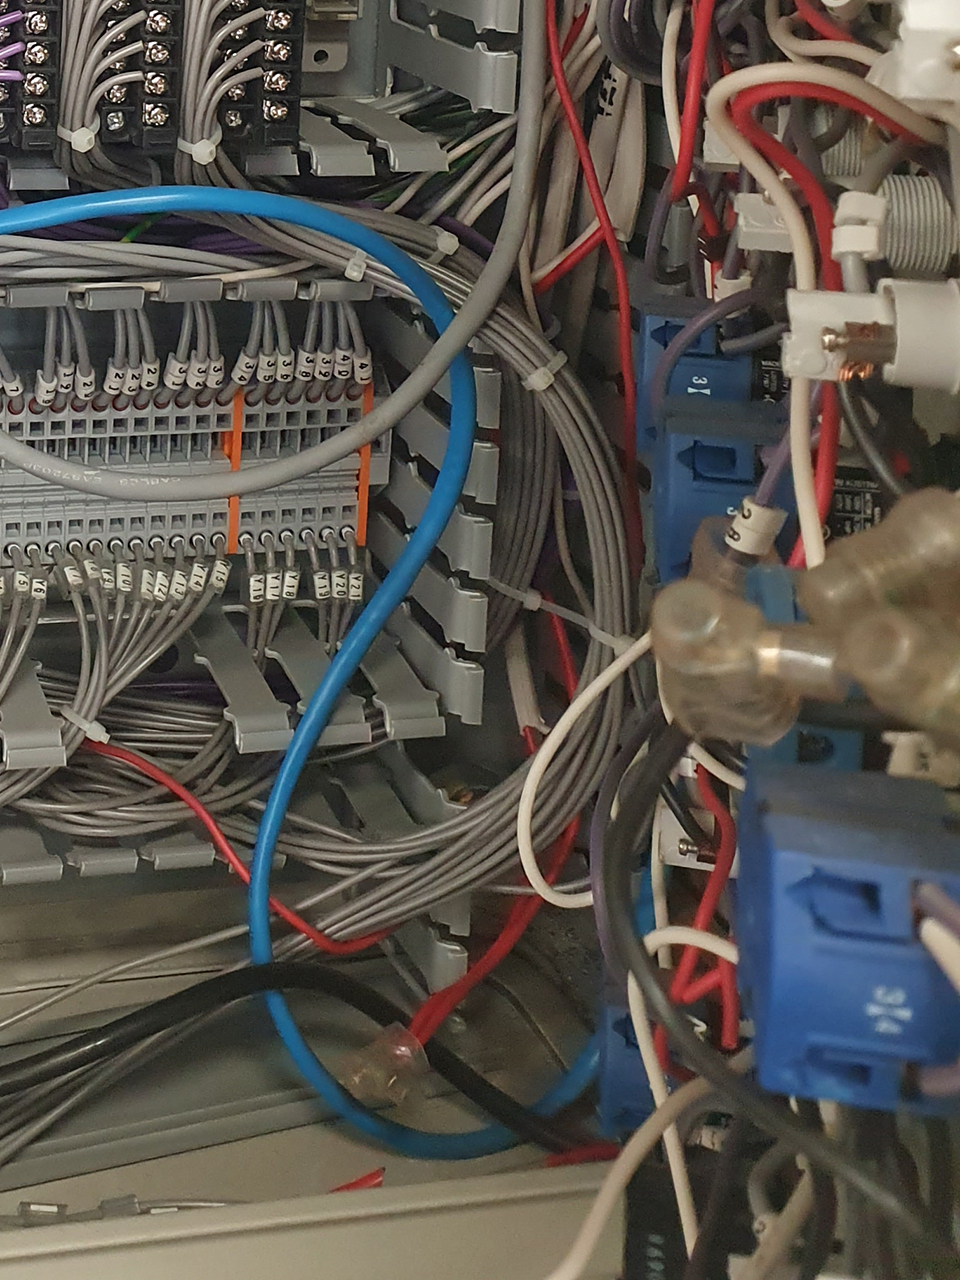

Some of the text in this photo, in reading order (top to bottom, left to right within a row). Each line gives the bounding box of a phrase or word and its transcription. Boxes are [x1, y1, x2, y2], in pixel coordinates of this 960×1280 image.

[263, 360, 276, 381] 35
[280, 360, 292, 380] 36
[300, 356, 315, 377] 38
[319, 357, 331, 377] 39
[338, 354, 351, 376] 40
[145, 367, 157, 388] 24
[18, 571, 29, 586] Y5
[193, 564, 205, 587] Y14
[216, 560, 228, 583] Y15
[34, 580, 45, 594] Y6
[174, 571, 187, 598] Y13
[270, 575, 280, 598] Y17
[285, 575, 298, 597] Y18
[318, 574, 329, 597] Y19
[336, 573, 346, 596] Y20
[351, 576, 361, 598] Y21
